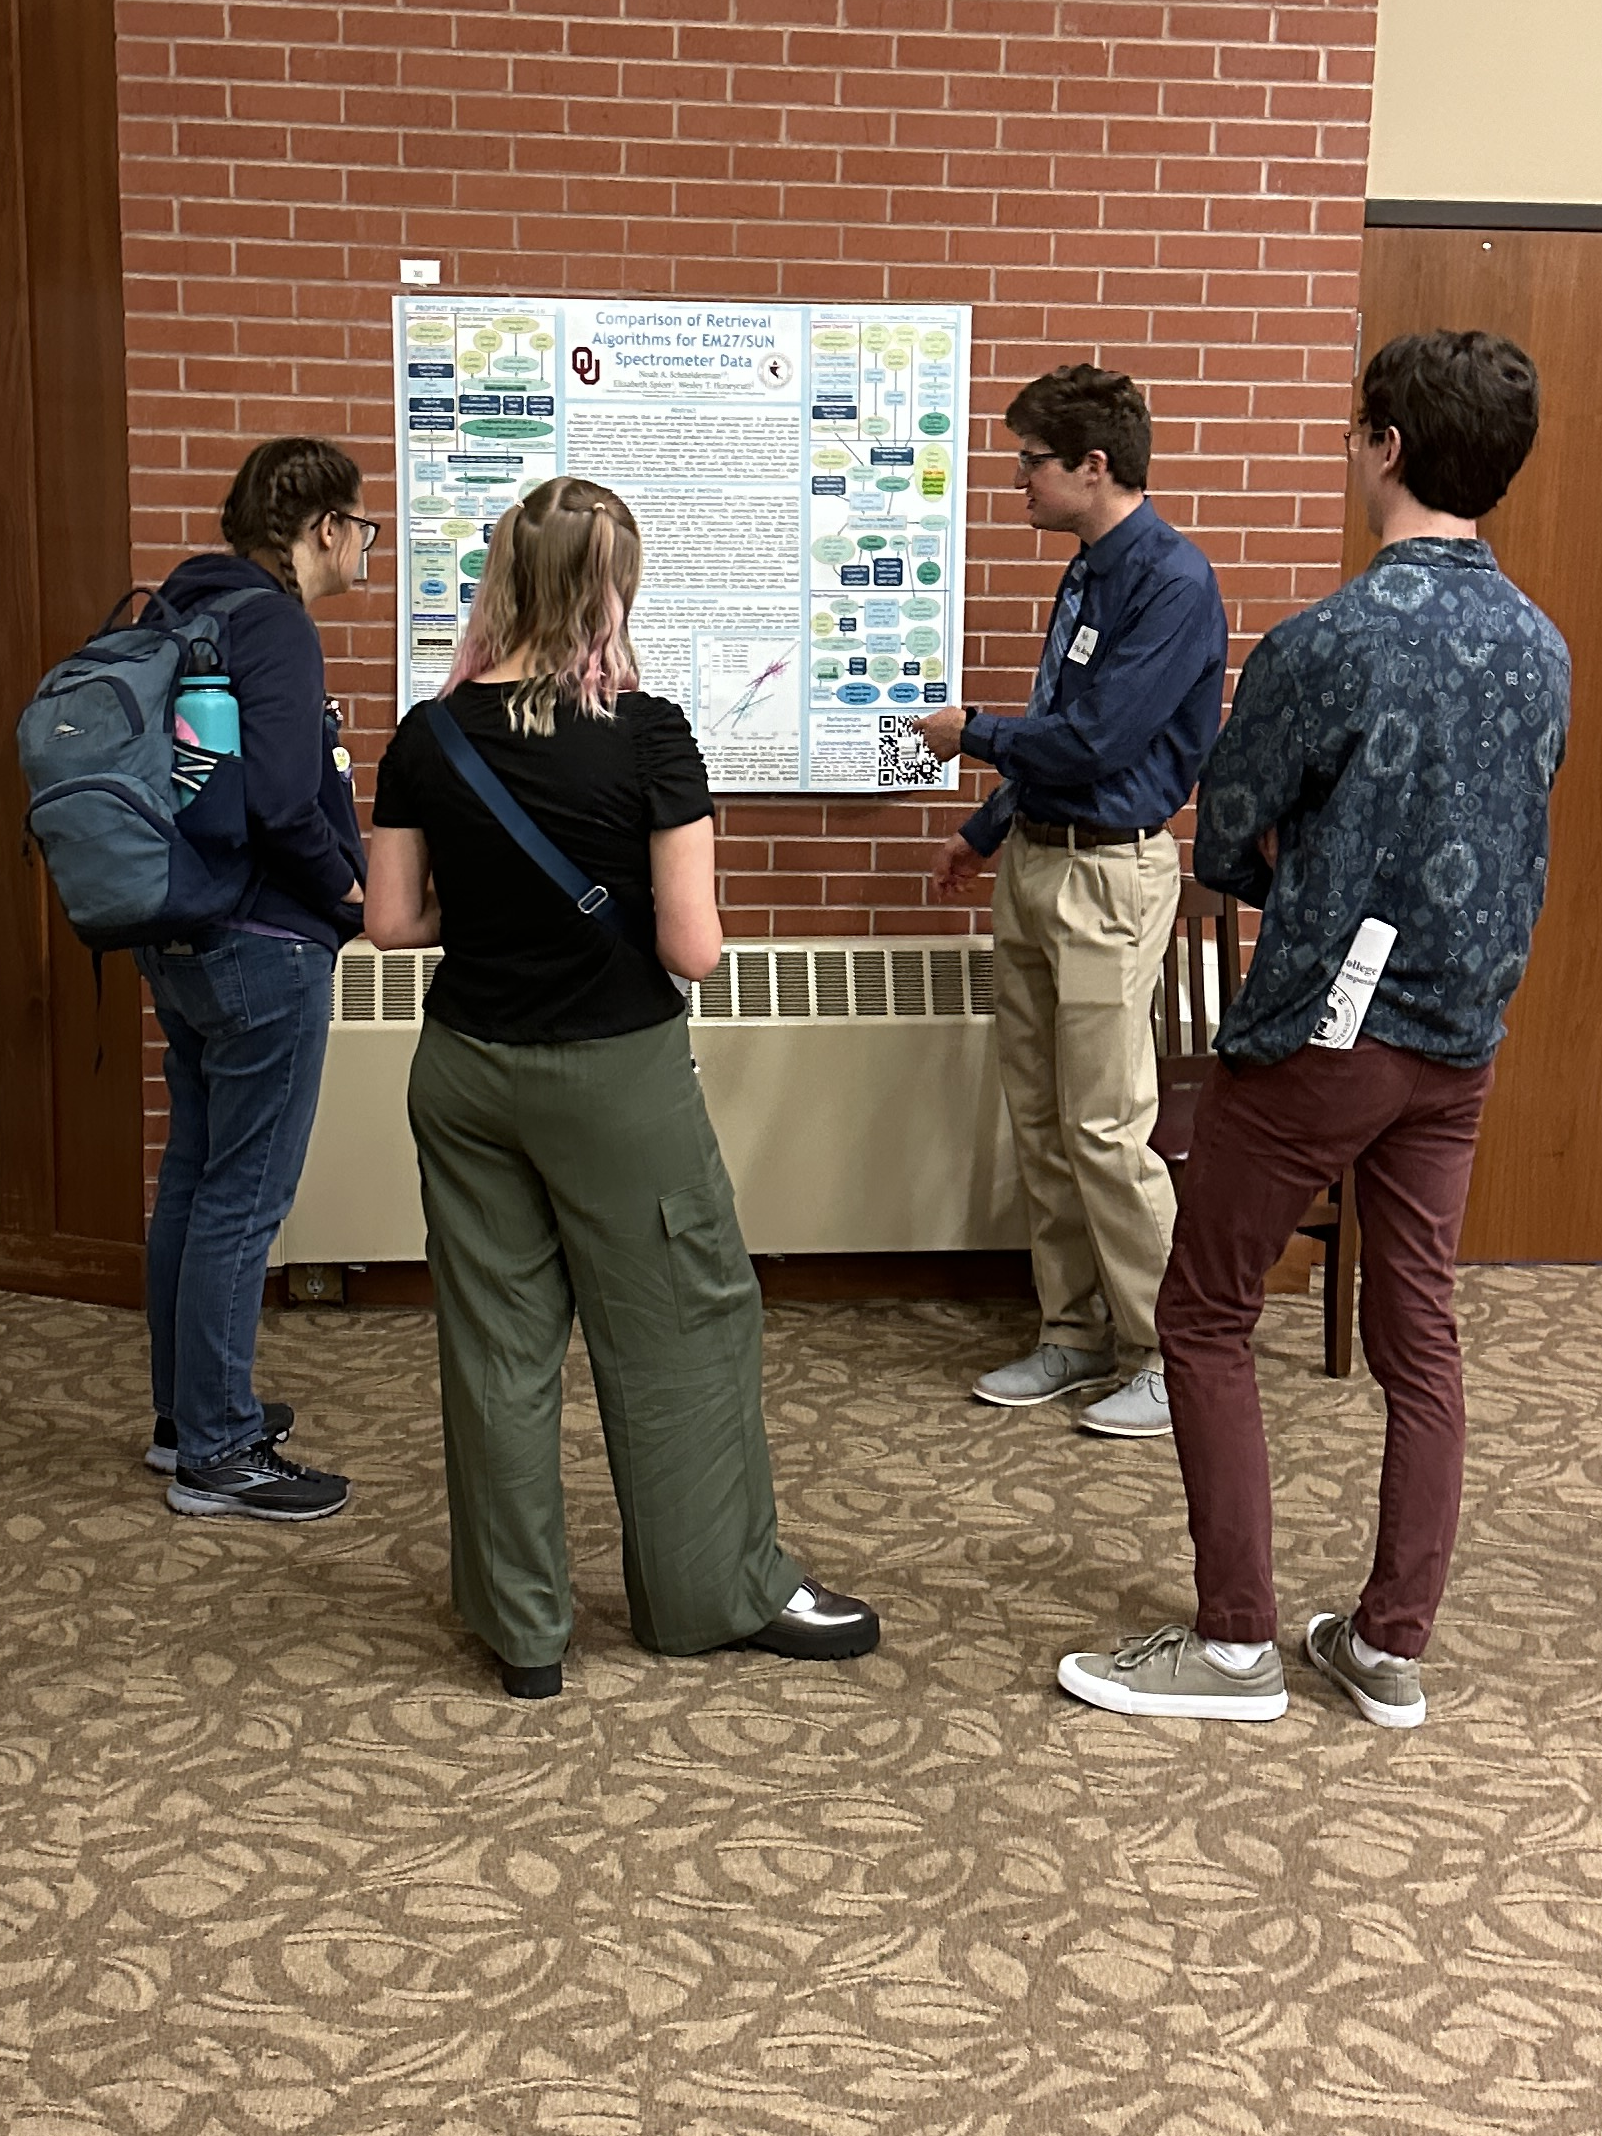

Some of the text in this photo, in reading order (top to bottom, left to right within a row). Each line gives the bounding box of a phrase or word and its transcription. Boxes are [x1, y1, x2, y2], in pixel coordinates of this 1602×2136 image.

[595, 311, 771, 328] Comparison of Retrieval
[591, 332, 775, 348] Algorithms for EM27/SUN
[572, 346, 600, 385] OU
[615, 351, 752, 369] Spectrometer Data
[1346, 959, 1378, 976] ollege
